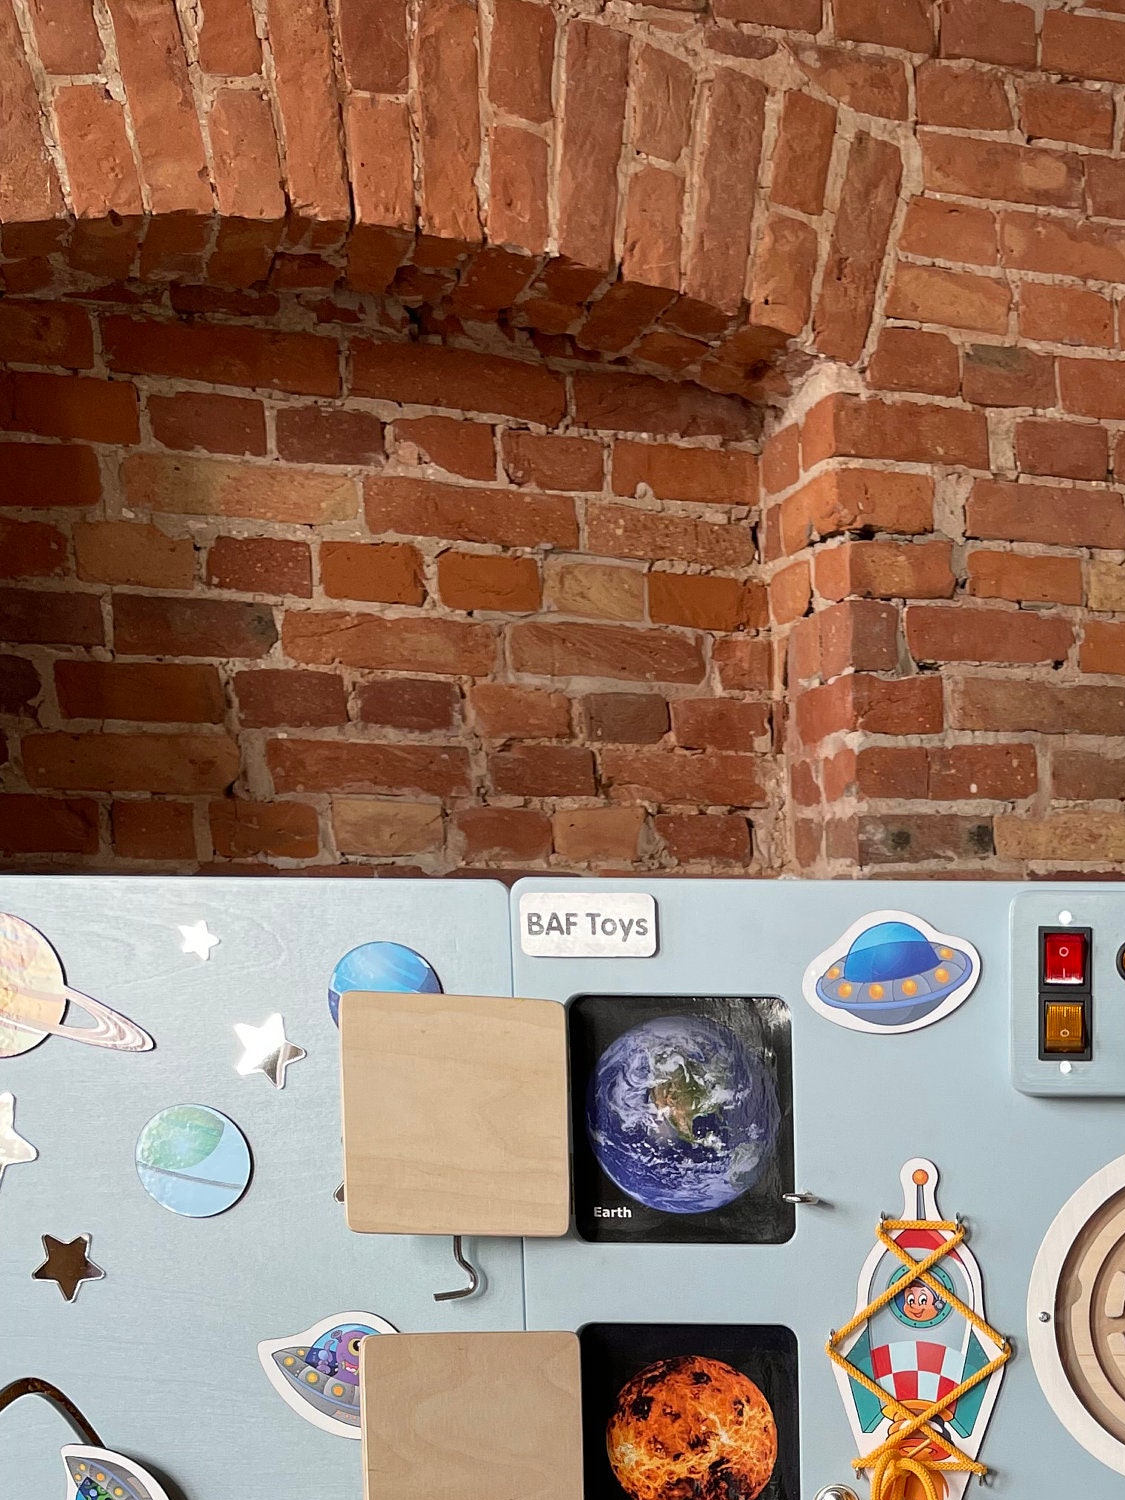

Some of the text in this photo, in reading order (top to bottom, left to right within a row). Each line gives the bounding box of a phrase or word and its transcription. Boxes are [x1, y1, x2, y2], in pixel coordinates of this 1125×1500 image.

[527, 912, 649, 942] BAF Toys
[593, 1206, 632, 1218] Earth
